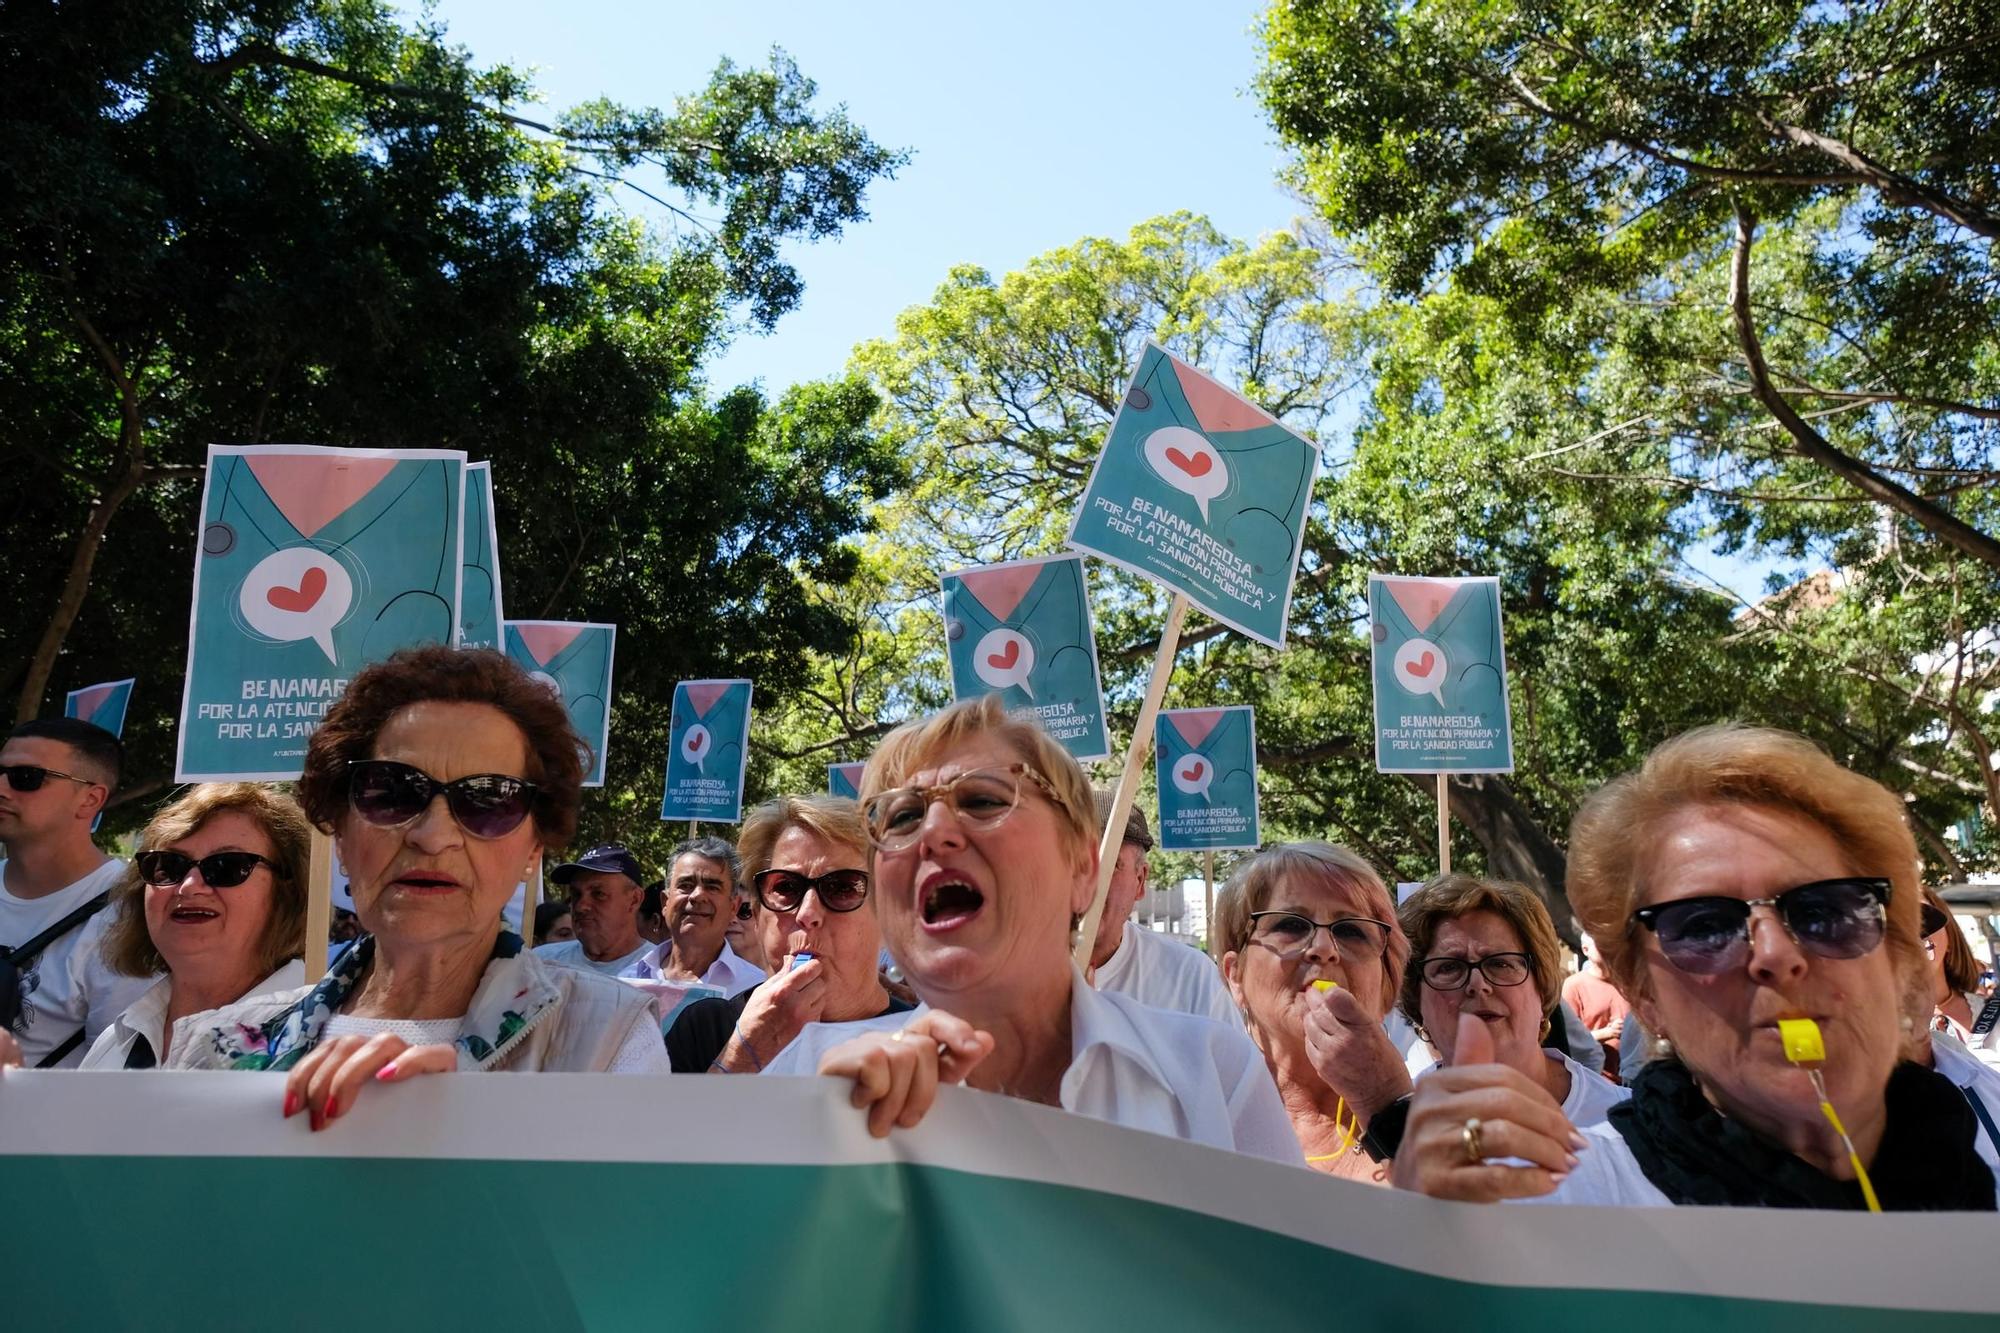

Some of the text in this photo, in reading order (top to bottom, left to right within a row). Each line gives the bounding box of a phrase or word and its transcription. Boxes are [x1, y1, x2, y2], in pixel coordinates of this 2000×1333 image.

[1131, 496, 1253, 578] BENAMARGOSA
[1094, 496, 1276, 603] POR LA ATENCIÓN PRIMARIA Y
[1106, 517, 1262, 611] POR LA SANIDAD PÚBLICA
[242, 678, 348, 699] BENAMAR
[198, 704, 233, 719] POR
[238, 704, 258, 719] LA
[1046, 713, 1095, 729] PRIMARIA Y
[1400, 715, 1482, 728] BENAMARGOSA
[218, 723, 252, 739] POR
[257, 723, 278, 738] LA
[1382, 728, 1501, 739] POR LA ATENCIÓN PRIMARIA Y
[1393, 740, 1494, 751] POR LA SANIDAD PÚBLICA
[1177, 808, 1239, 818] BENAMARGOSA
[1164, 819, 1176, 827] POR
[1194, 826, 1220, 834] SANIDAD
